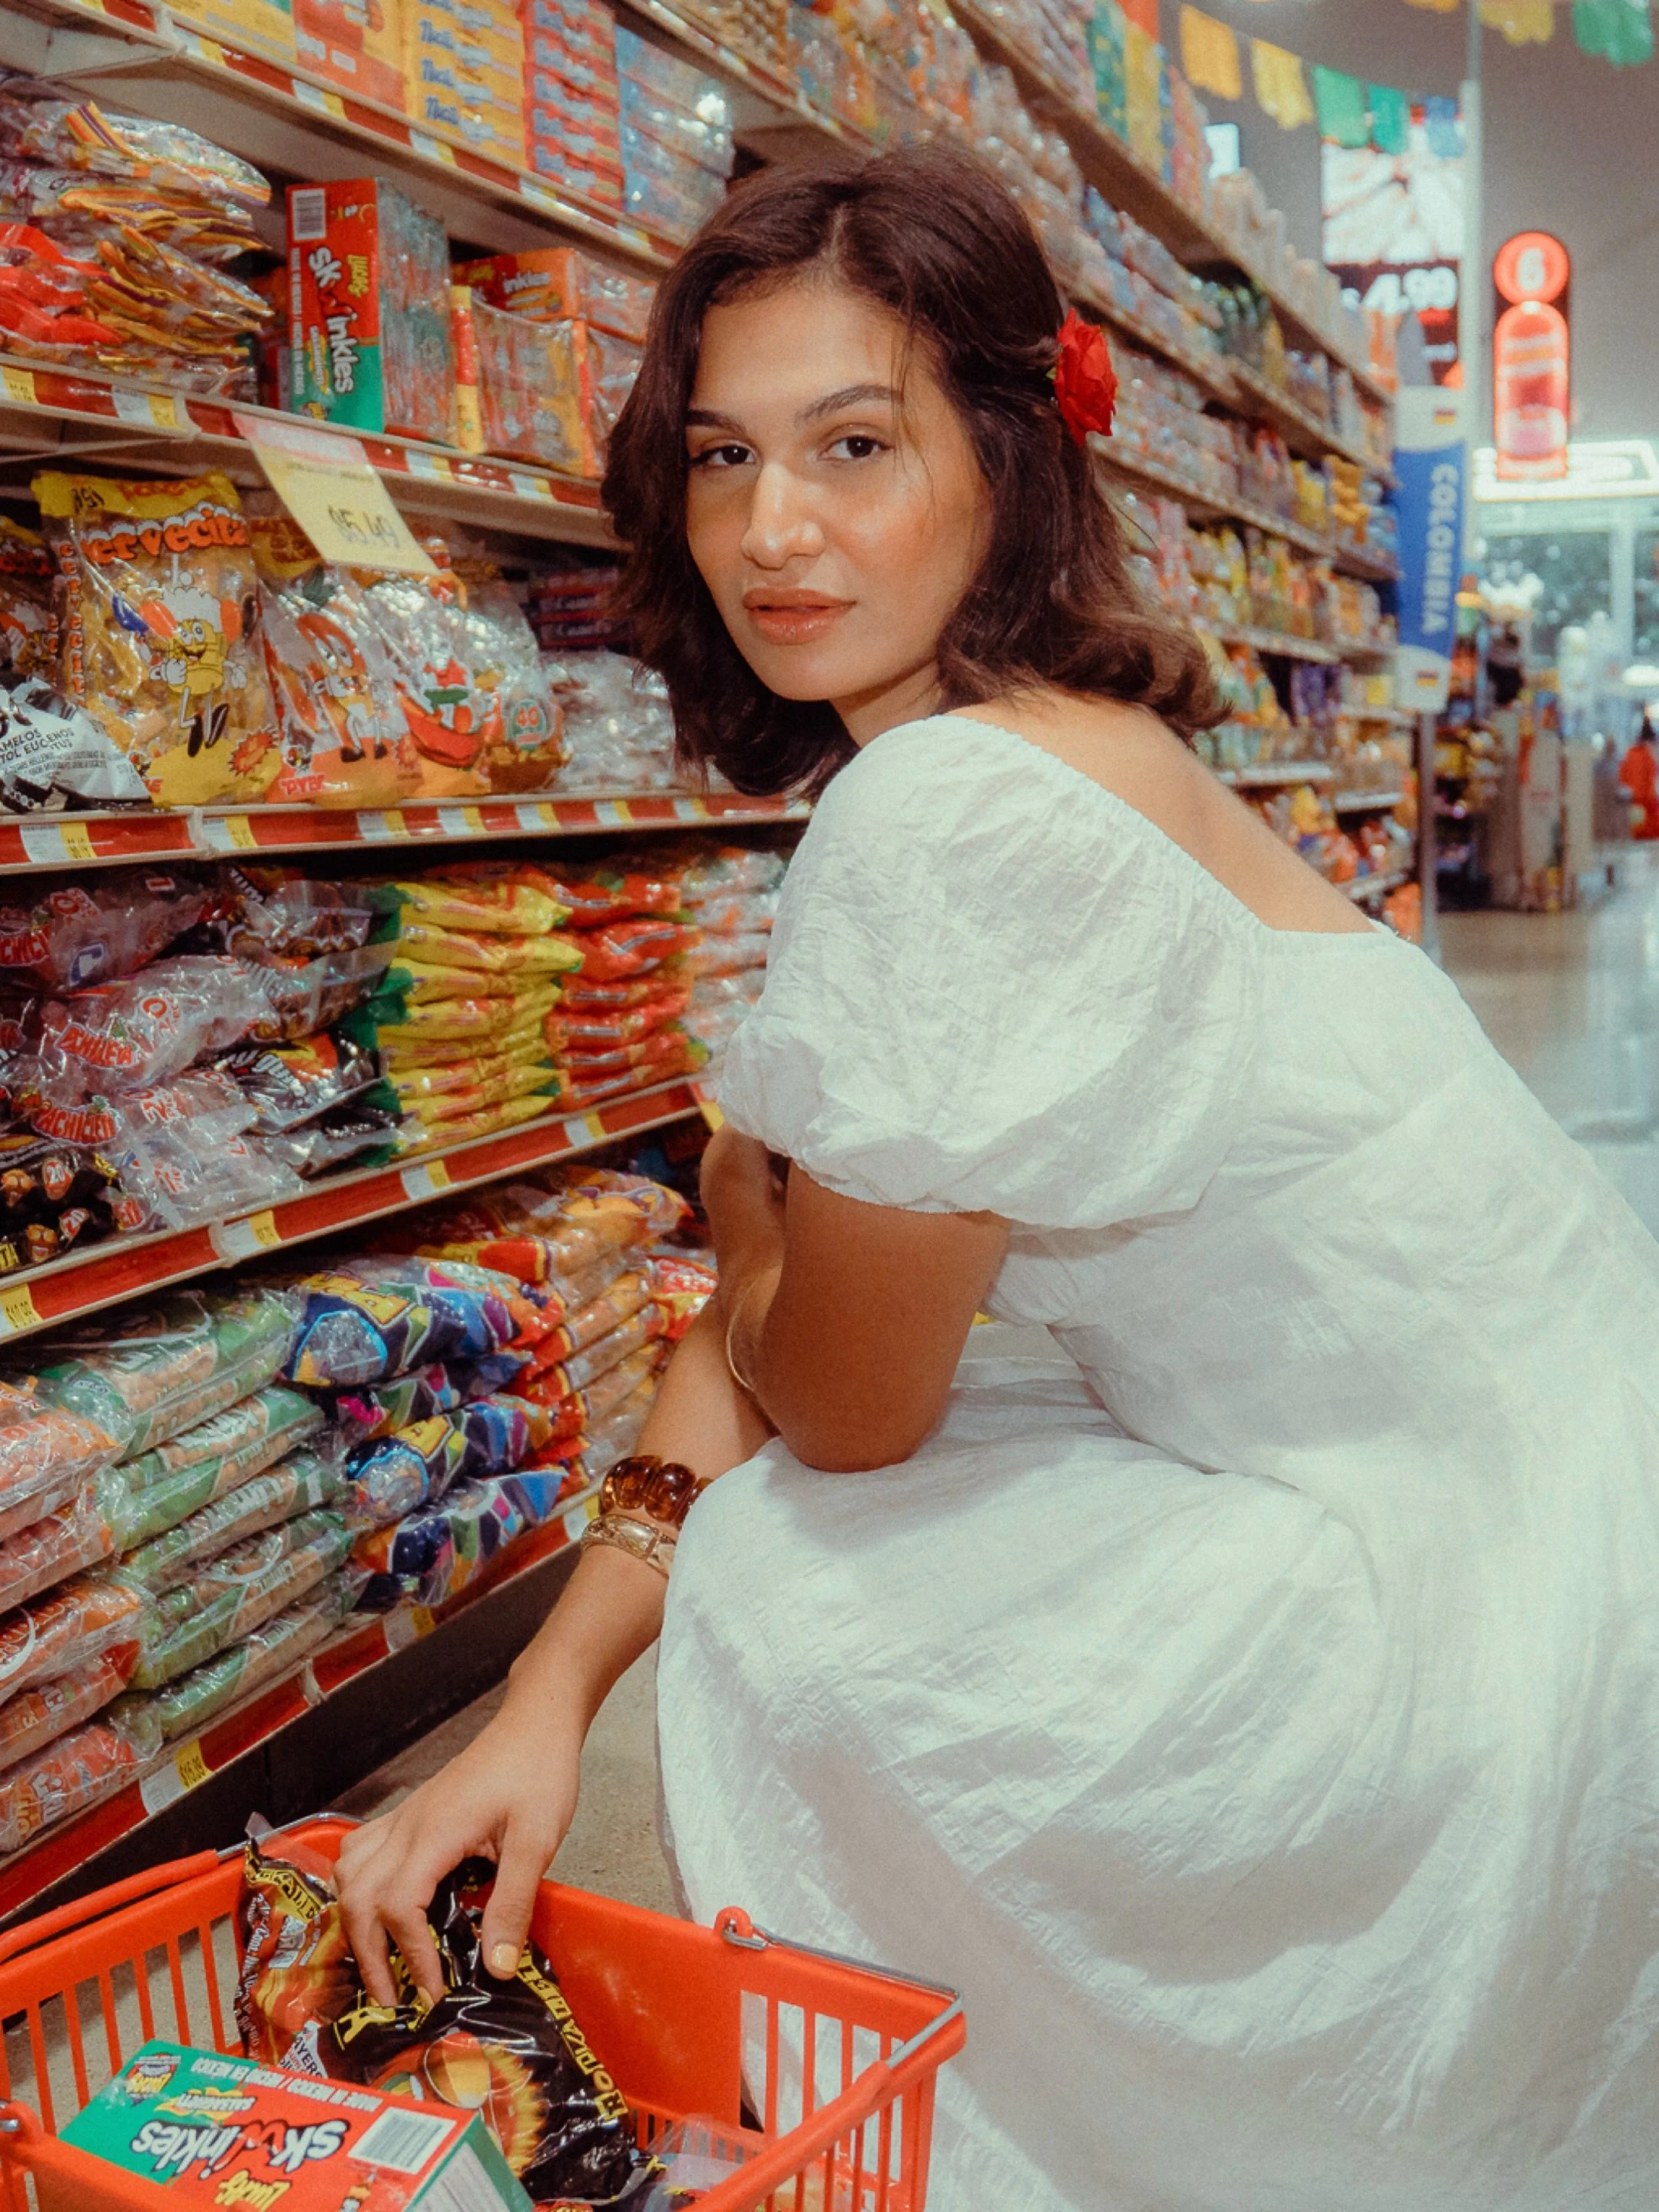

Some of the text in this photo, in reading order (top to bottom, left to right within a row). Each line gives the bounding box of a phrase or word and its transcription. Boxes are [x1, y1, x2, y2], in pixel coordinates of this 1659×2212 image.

[1341, 267, 1458, 316] 4.99
[1422, 463, 1458, 636] COLOMBIA
[343, 2091, 382, 2112] MADE
